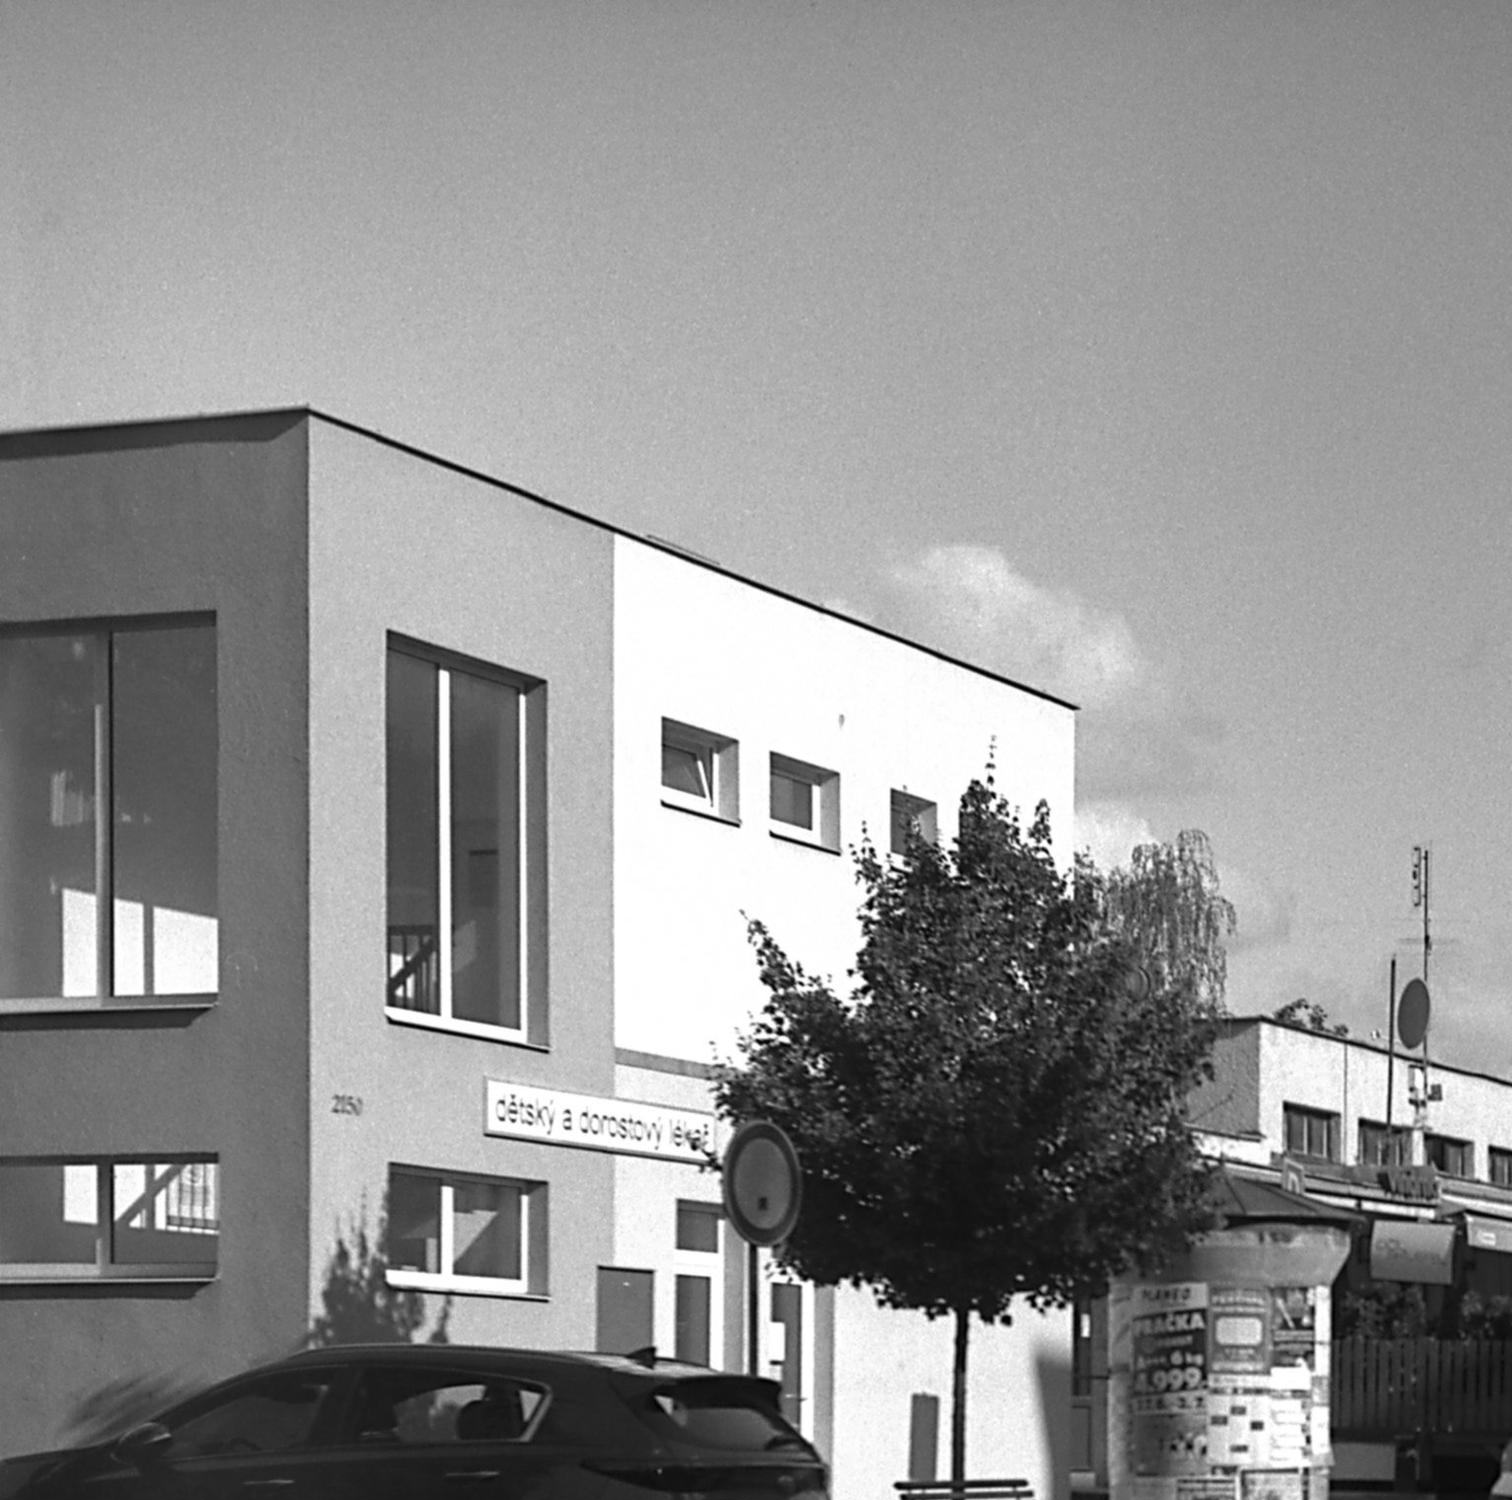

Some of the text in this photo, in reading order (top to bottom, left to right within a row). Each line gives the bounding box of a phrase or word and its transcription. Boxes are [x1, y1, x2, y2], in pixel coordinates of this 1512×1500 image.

[495, 1094, 555, 1135] dětský
[562, 1108, 572, 1130] a
[579, 1106, 663, 1150] dorostový
